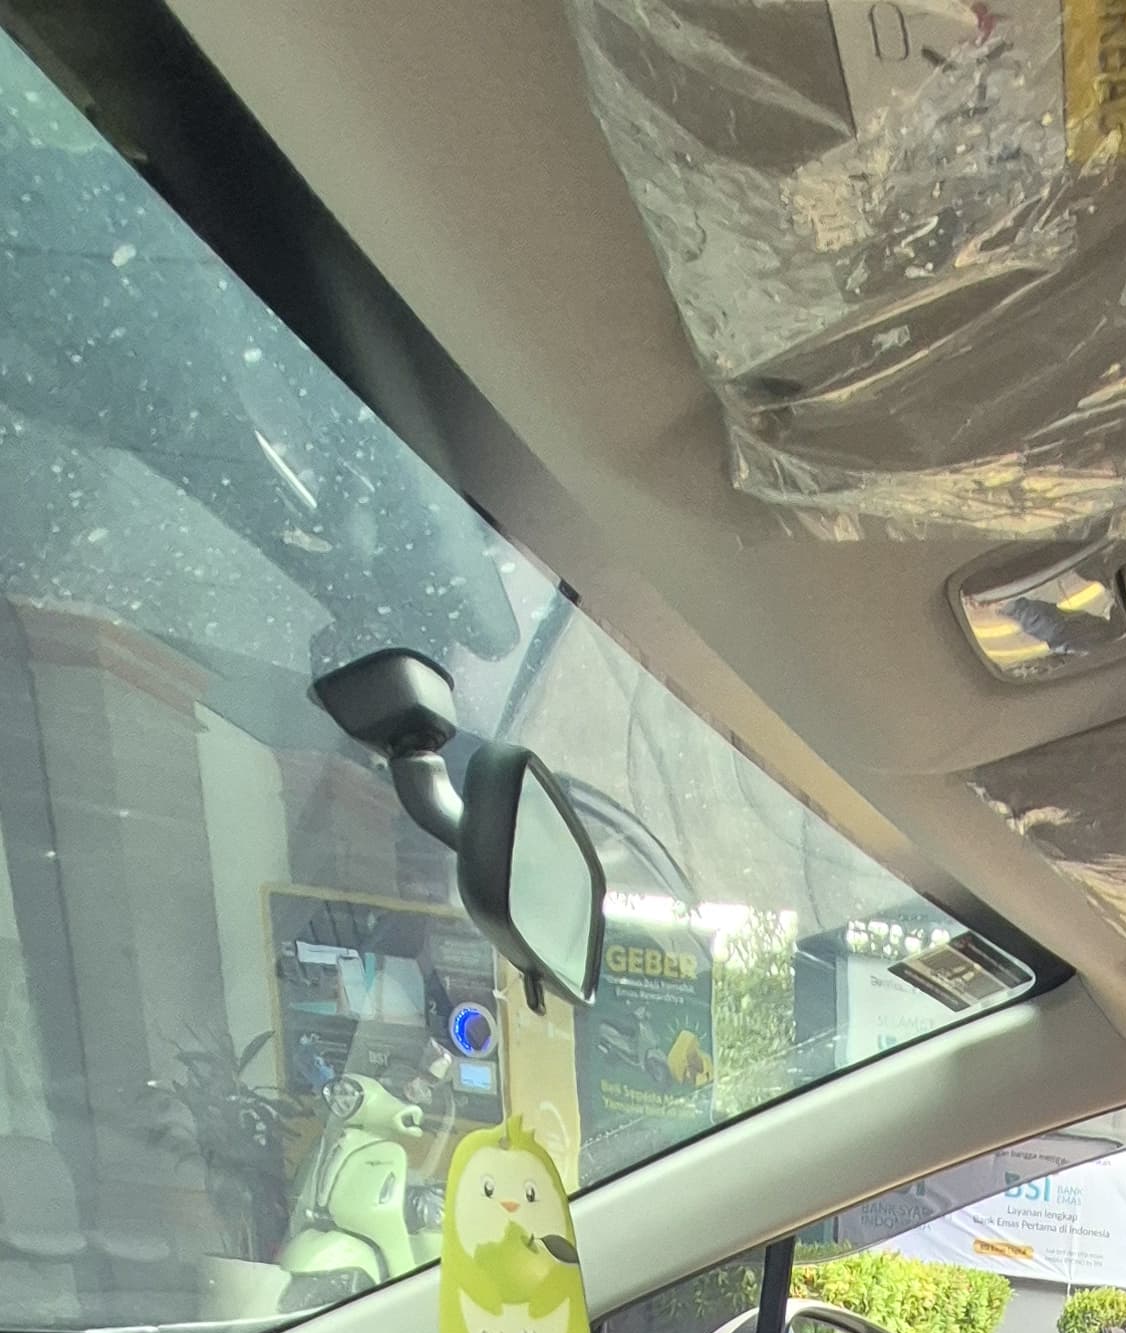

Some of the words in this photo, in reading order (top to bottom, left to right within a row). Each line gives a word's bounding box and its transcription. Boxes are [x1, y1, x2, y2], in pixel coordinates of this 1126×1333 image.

[606, 944, 698, 979] GEBER
[1007, 1205, 1042, 1218] Layanan
[1044, 1208, 1078, 1222] lengkap
[997, 1217, 1019, 1228] Emas
[1021, 1219, 1058, 1233] Pertama
[1059, 1223, 1067, 1233] di
[1069, 1225, 1110, 1239] Indonesia
